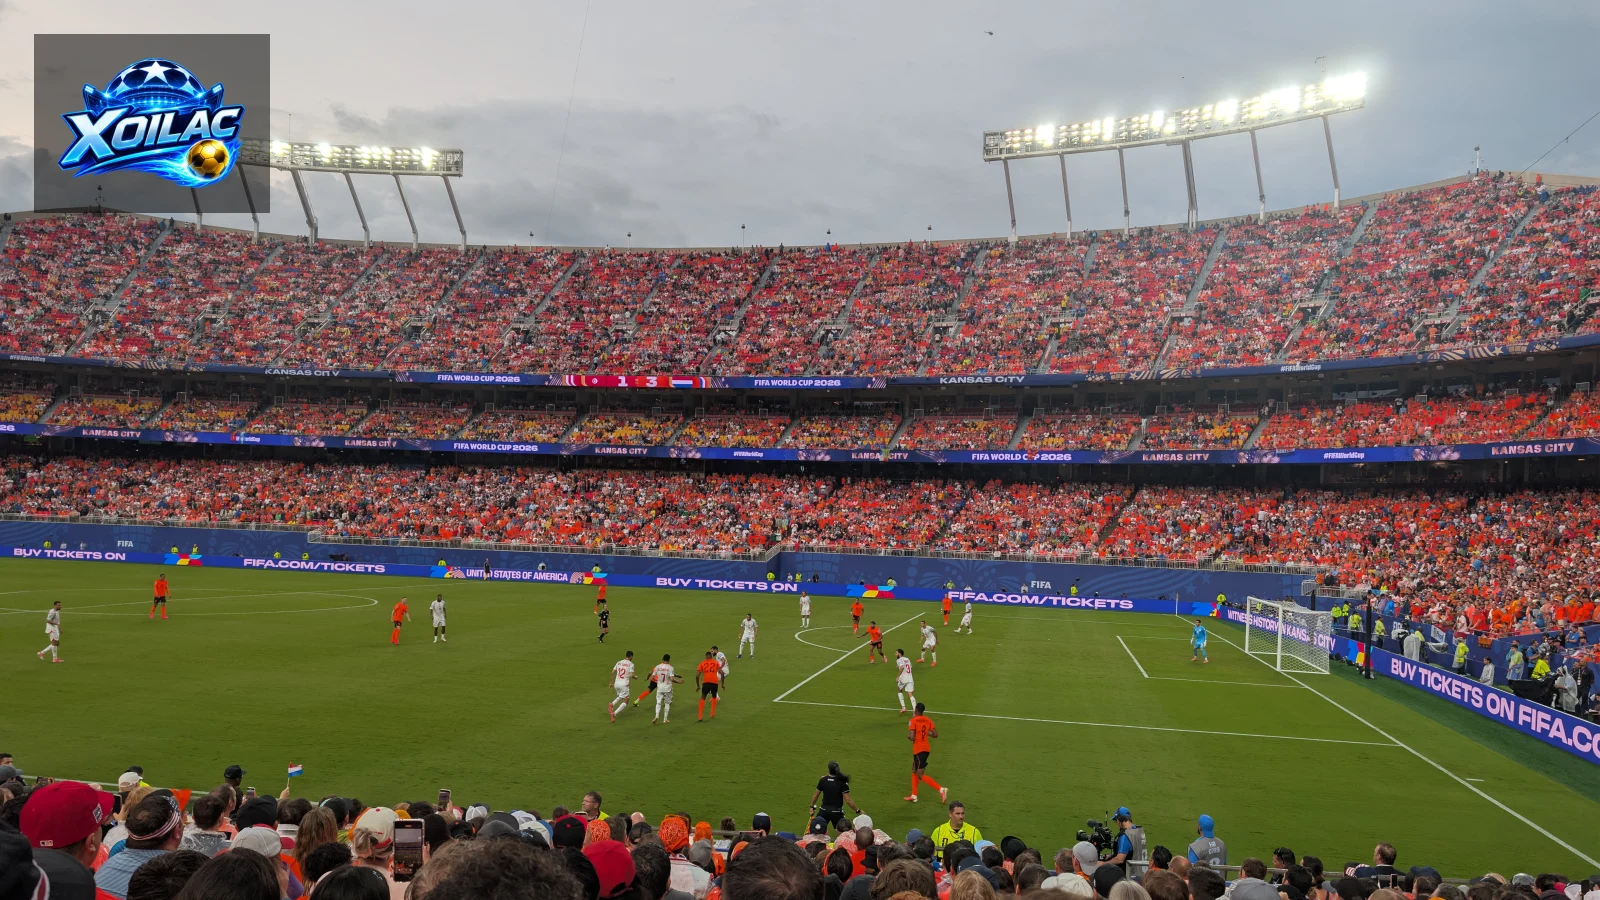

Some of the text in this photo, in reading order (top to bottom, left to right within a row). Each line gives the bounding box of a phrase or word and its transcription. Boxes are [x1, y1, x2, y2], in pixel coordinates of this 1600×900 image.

[265, 368, 312, 376] KANSAS
[480, 375, 495, 383] CUP
[617, 376, 658, 387] 1 3
[770, 379, 798, 387] WORLD
[798, 379, 814, 387] CUP
[939, 376, 993, 384] KANSAS
[82, 428, 141, 438] KANSAS CITY
[344, 439, 378, 447] KANSAS
[453, 442, 469, 450] FIFA
[468, 443, 497, 451] WORLD
[512, 444, 538, 452] 2026
[595, 447, 648, 455] KANSAS CITY
[1491, 442, 1575, 455] KANSAS CITY
[851, 452, 908, 460] KANSA CITY
[971, 453, 1072, 461] FIFA WORLD CP 2026
[1142, 453, 1210, 461] KANSAS CITY
[1323, 451, 1365, 459] #FIFAWorldCup
[13, 548, 126, 561] BUY TICKETS ON
[243, 558, 386, 573] FIFA.COM/TICKETS
[466, 569, 568, 582] UNITD STATES OF AMERICA
[655, 577, 798, 592] BUY TICKETS ON
[1030, 580, 1052, 589] FIFA
[948, 591, 1134, 609] FIFA.COM/TICKETS
[1227, 609, 1253, 625] WITNESS
[1253, 615, 1279, 632] HISTORY
[1317, 633, 1336, 651] CITY
[703, 662, 716, 673] 22
[905, 663, 911, 674] 3
[617, 667, 626, 679] 12
[660, 673, 666, 683] 7
[1391, 657, 1417, 681] BUY
[1418, 667, 1483, 709] TICKETS
[1485, 692, 1515, 722] ON
